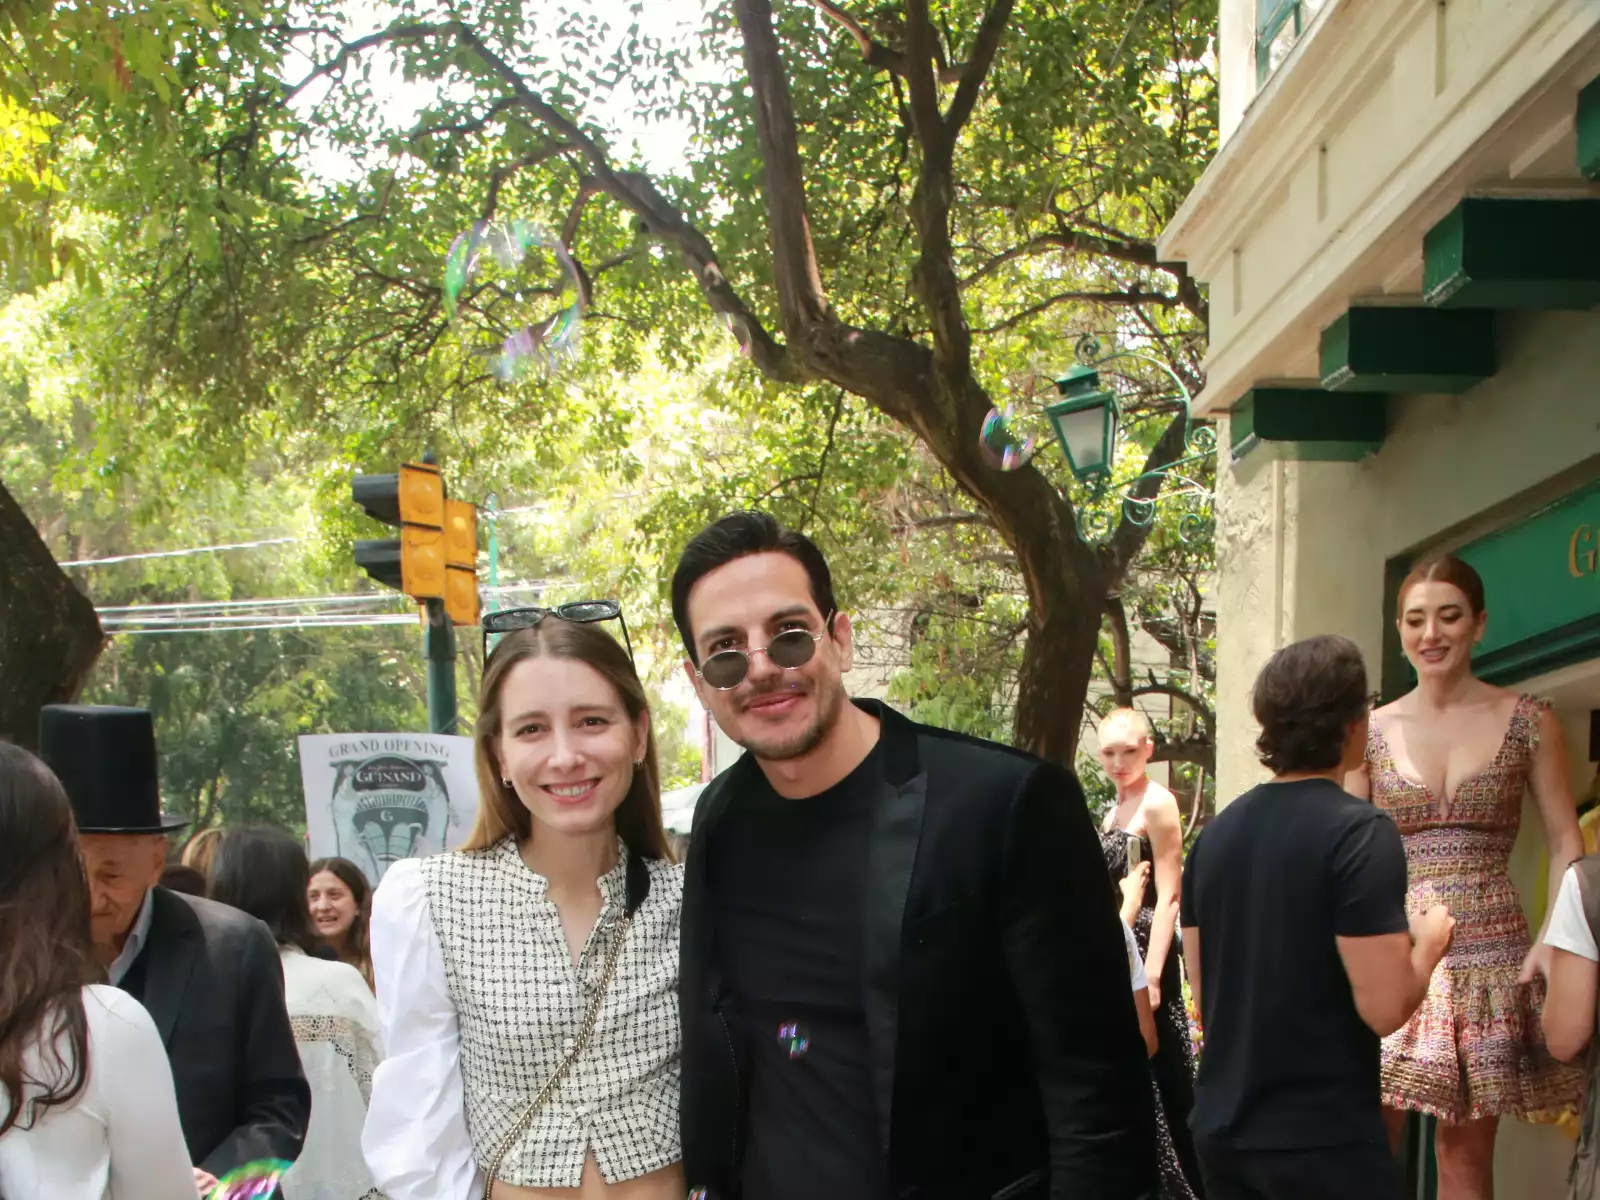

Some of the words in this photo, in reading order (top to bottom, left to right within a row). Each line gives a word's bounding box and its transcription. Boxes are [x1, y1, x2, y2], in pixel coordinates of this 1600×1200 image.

[329, 740, 379, 757] GRAND
[384, 739, 449, 758] OPENING
[356, 771, 422, 782] GUINAND
[380, 809, 394, 821] G
